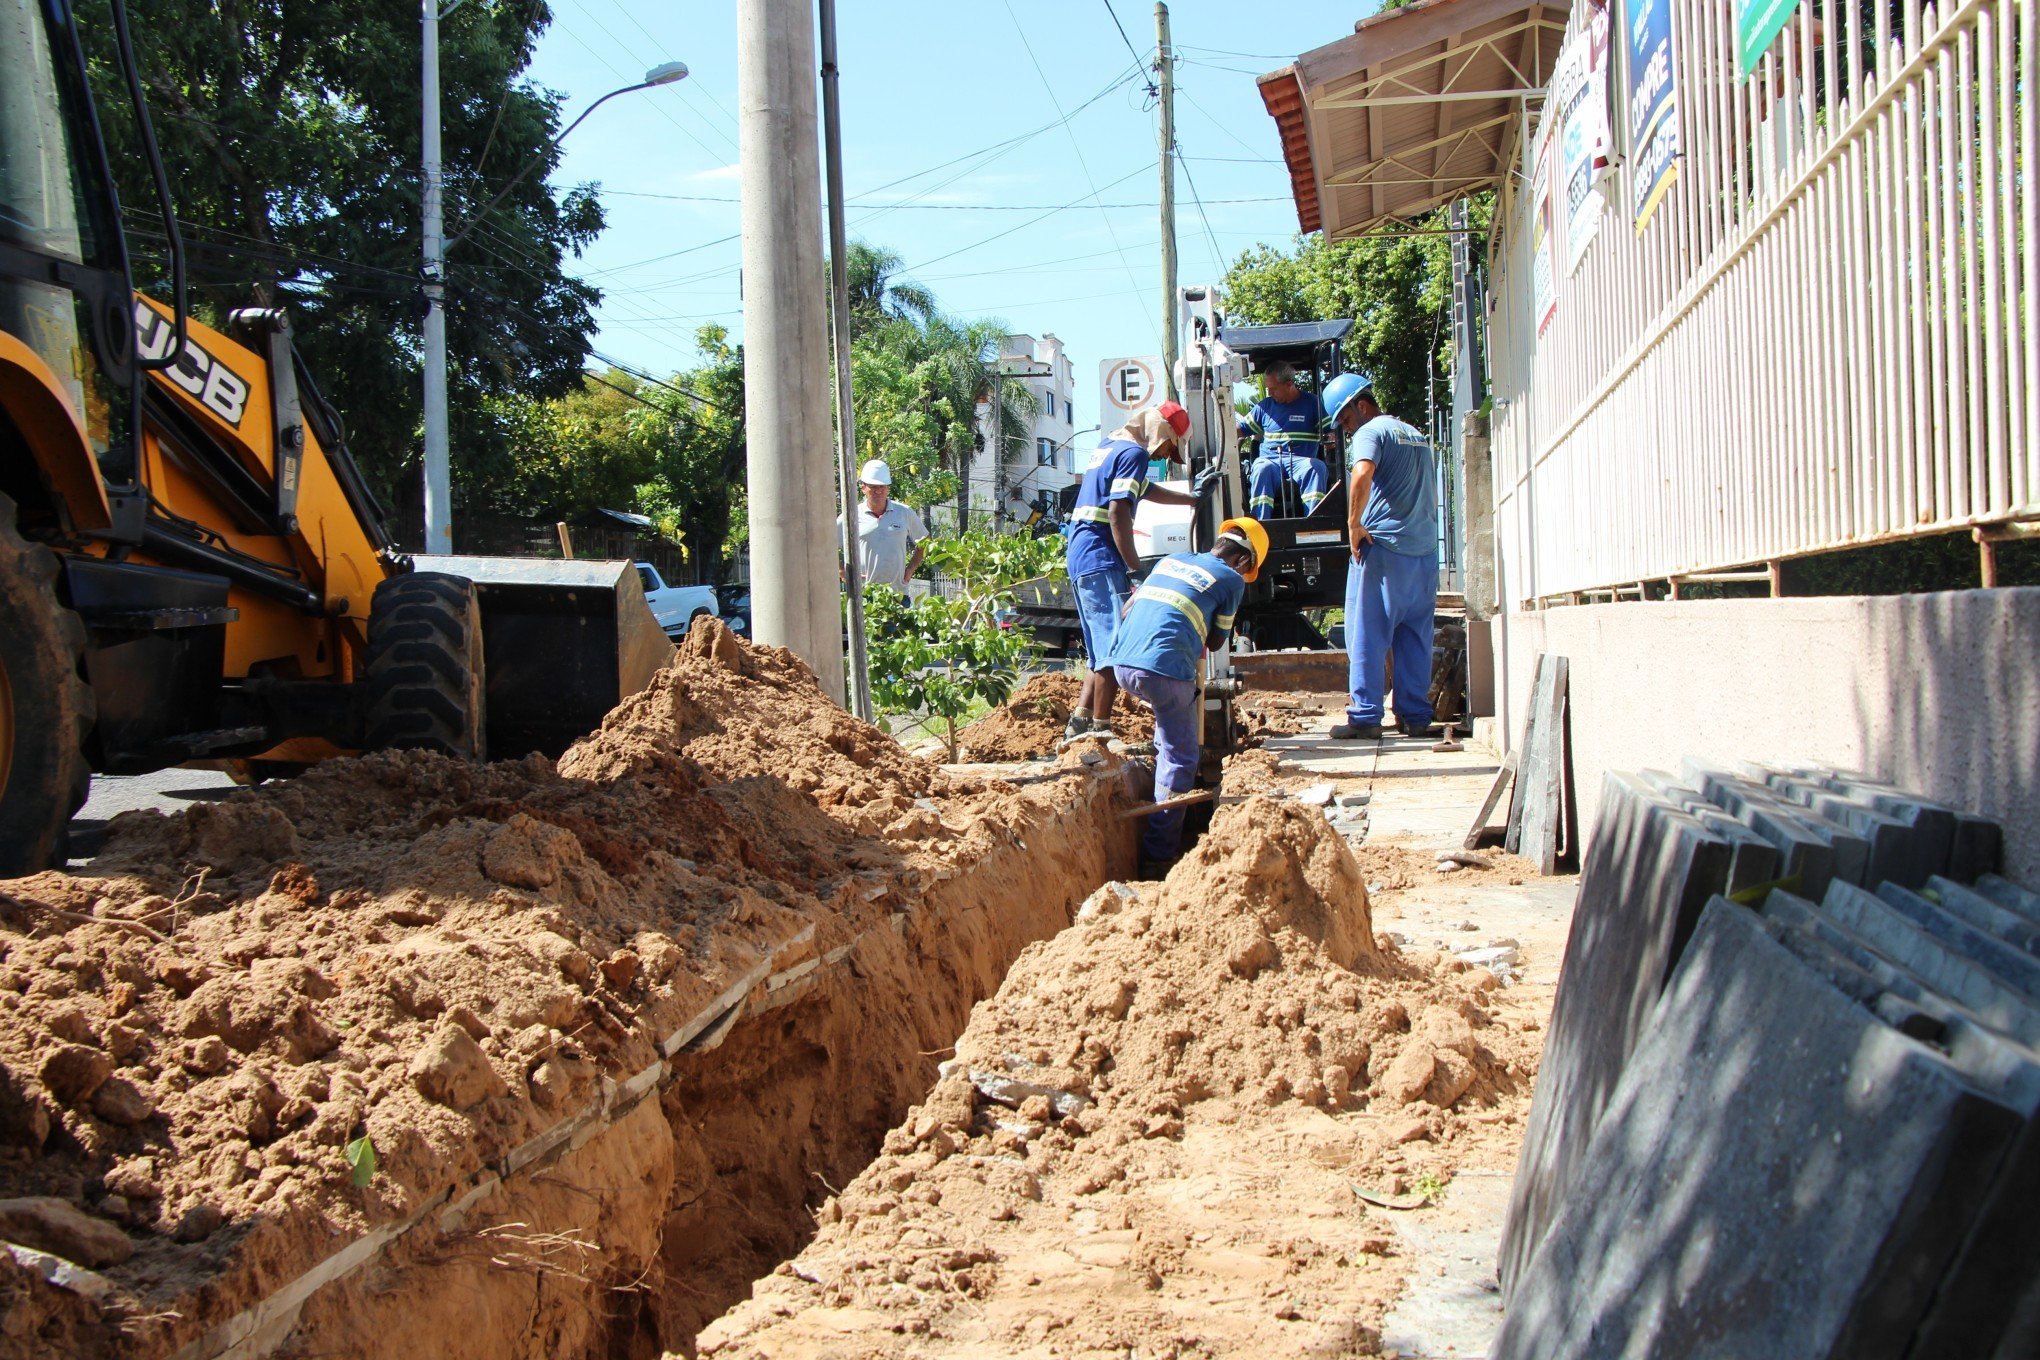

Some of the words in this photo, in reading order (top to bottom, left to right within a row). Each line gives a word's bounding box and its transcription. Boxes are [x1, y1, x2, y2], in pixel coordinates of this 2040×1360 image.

[1632, 38, 1669, 137] COMPRE
[135, 302, 247, 423] JCB
[1120, 368, 1140, 401] E
